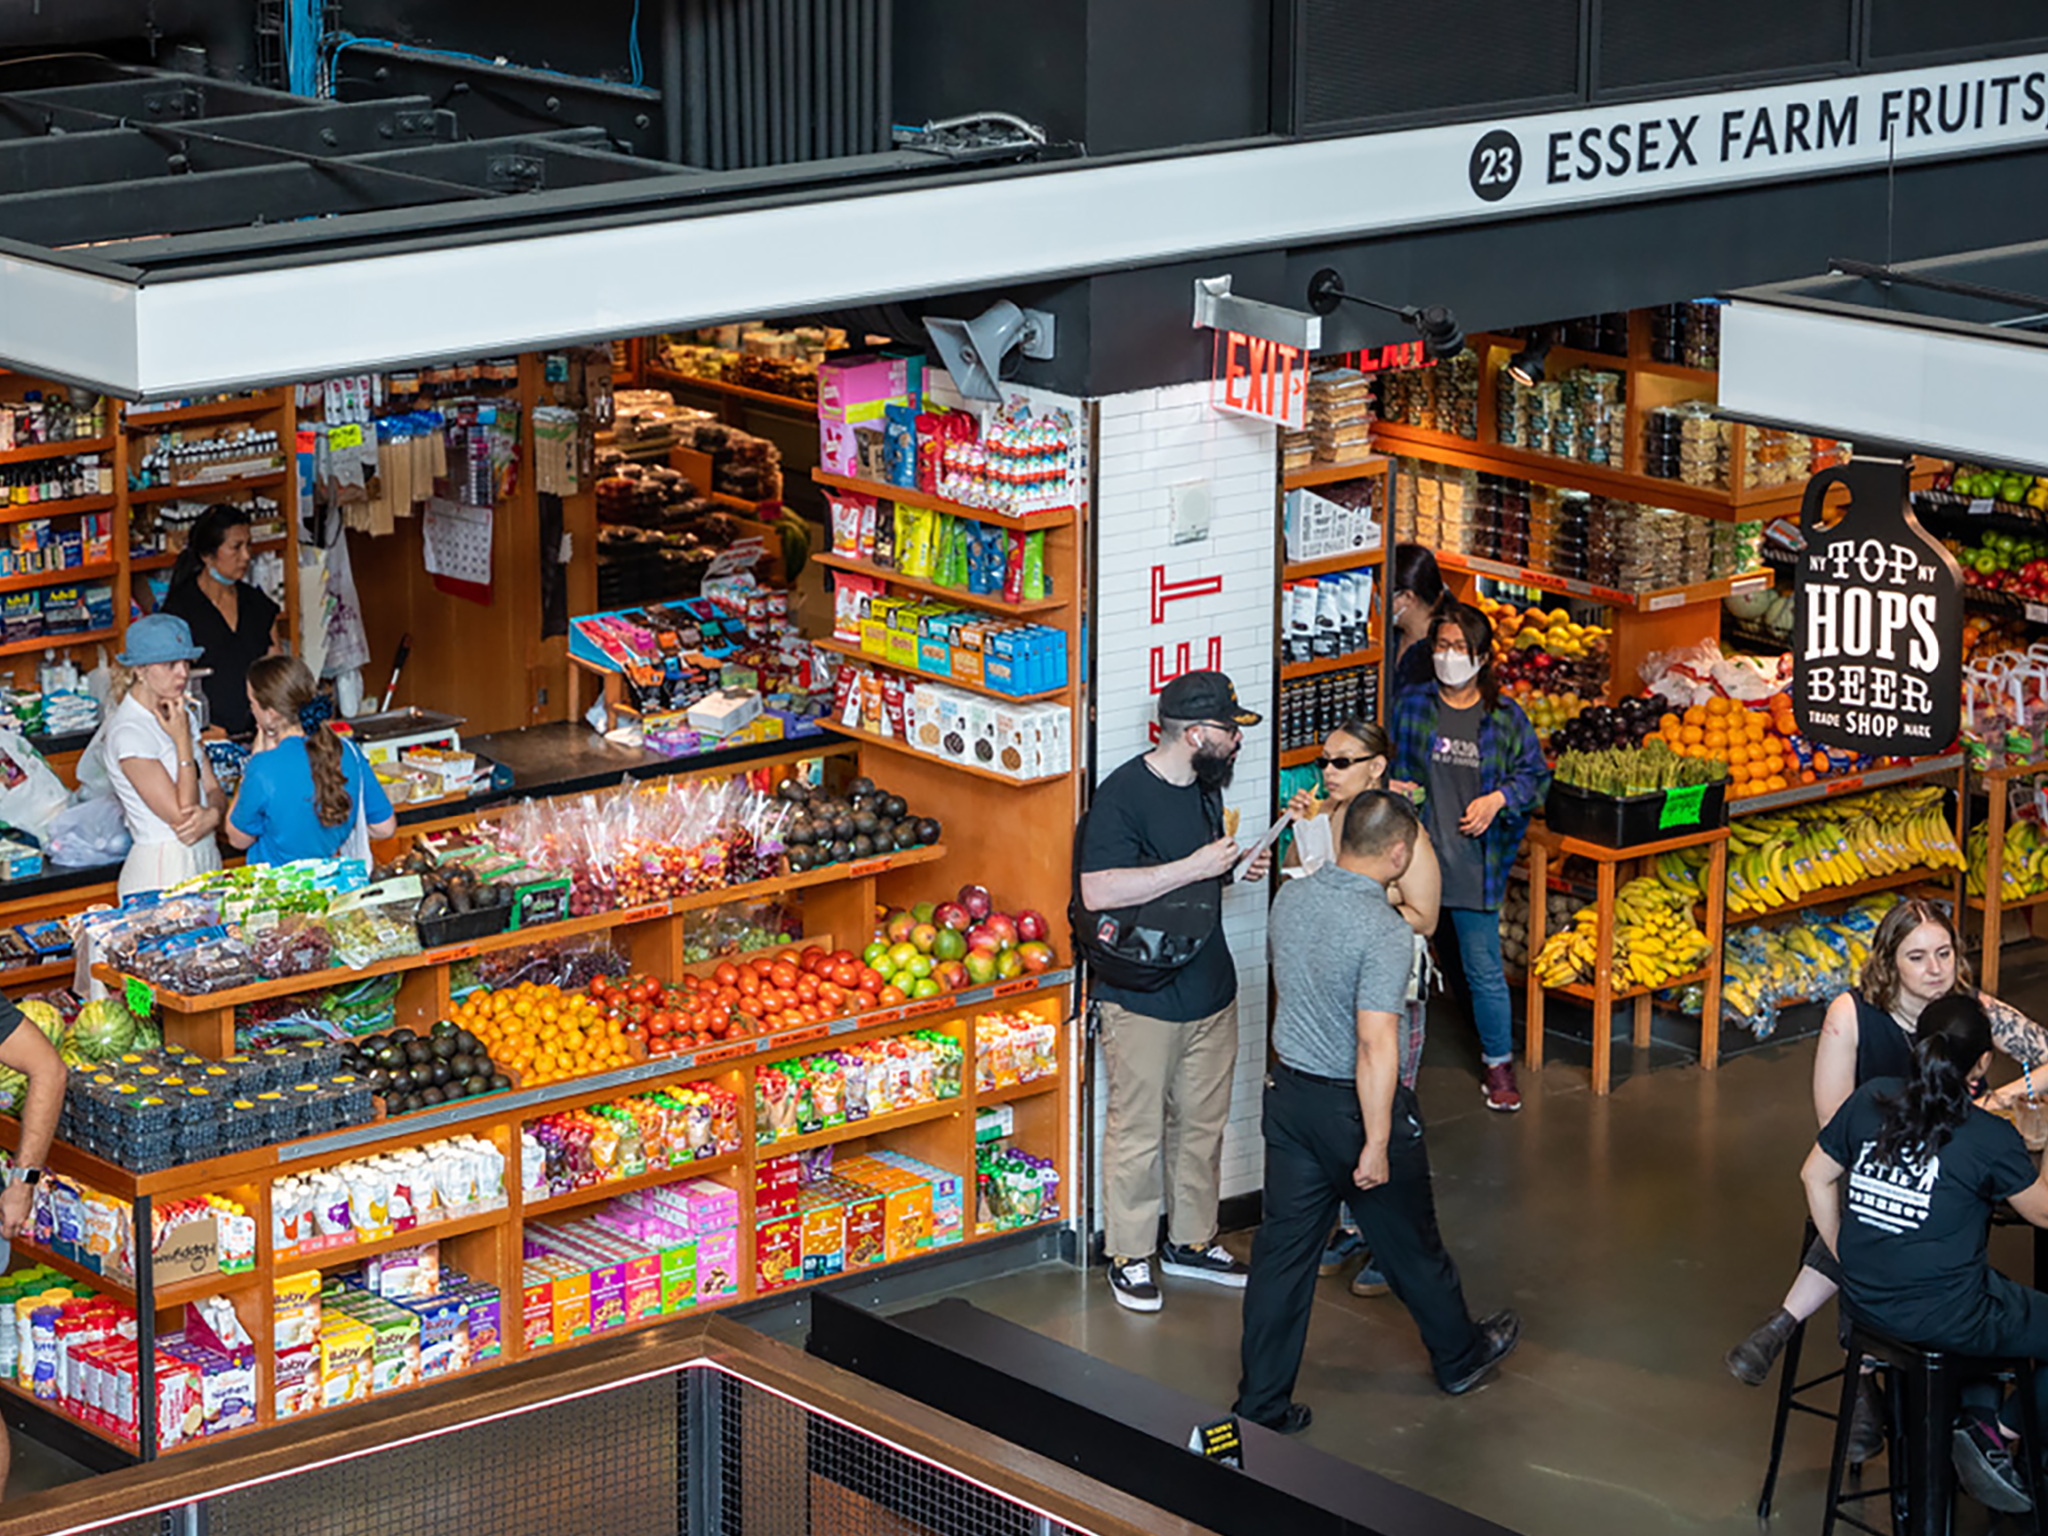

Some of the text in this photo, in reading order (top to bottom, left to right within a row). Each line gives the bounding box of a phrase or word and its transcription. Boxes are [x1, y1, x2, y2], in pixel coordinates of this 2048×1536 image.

[1479, 146, 1513, 185] 23
[1547, 115, 1698, 185] ESSEX
[1720, 95, 1859, 162] FARM
[1225, 329, 1298, 420] EXIT
[1809, 538, 1937, 585] NY TOP NY
[1804, 583, 1940, 674] HOPS
[1807, 665, 1933, 714] BEER
[1808, 710, 1840, 727] TRADE
[1845, 710, 1899, 738] SHOP
